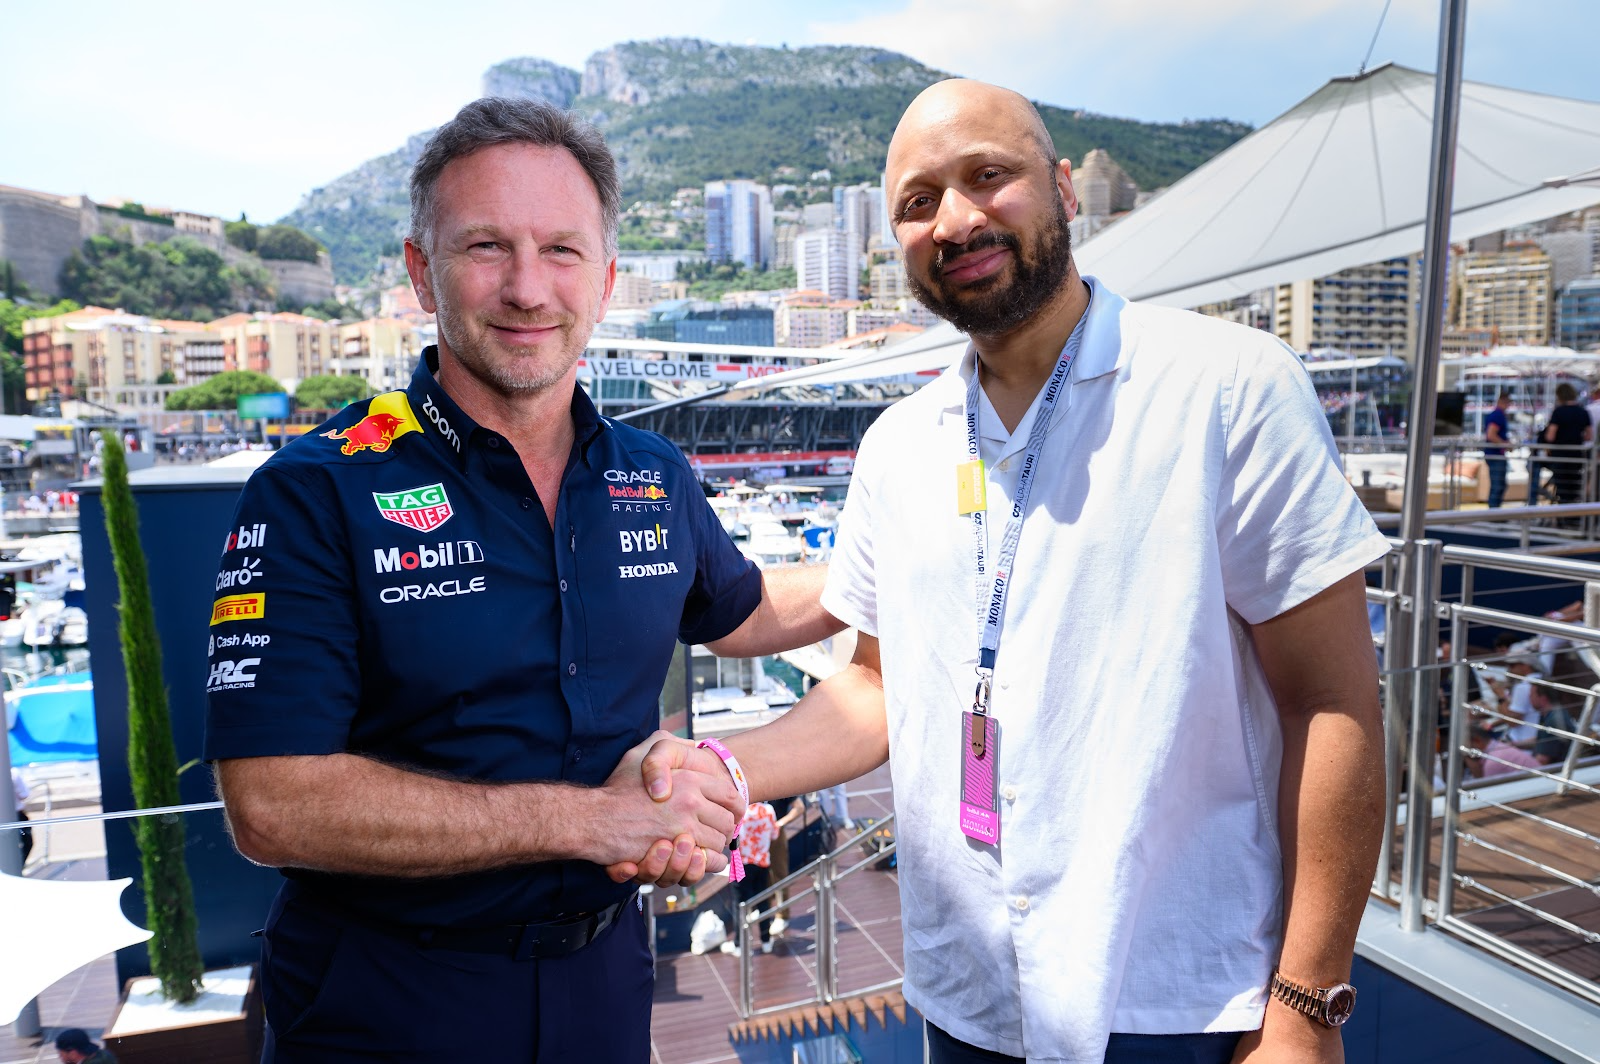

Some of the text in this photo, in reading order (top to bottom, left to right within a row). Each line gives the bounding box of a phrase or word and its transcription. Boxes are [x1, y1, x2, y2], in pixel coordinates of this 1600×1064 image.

[590, 360, 711, 378] WELCOME
[1045, 360, 1068, 403] MONACO
[422, 394, 461, 453] zoom
[967, 413, 978, 454] MONACO
[603, 469, 662, 484] ORACLE
[380, 488, 441, 508] TAG
[612, 503, 672, 513] RACING
[385, 505, 449, 531] HEUER
[619, 523, 668, 553] BYBIT
[373, 541, 454, 574] Mobil
[618, 561, 679, 579] HONDA
[215, 566, 252, 591] Claro
[379, 576, 487, 604] ORACLE
[213, 598, 258, 621] PIRELLI
[987, 578, 1005, 627] MONACO
[216, 632, 271, 649] Cash App
[206, 657, 262, 688] HRC
[223, 681, 256, 690] RACING
